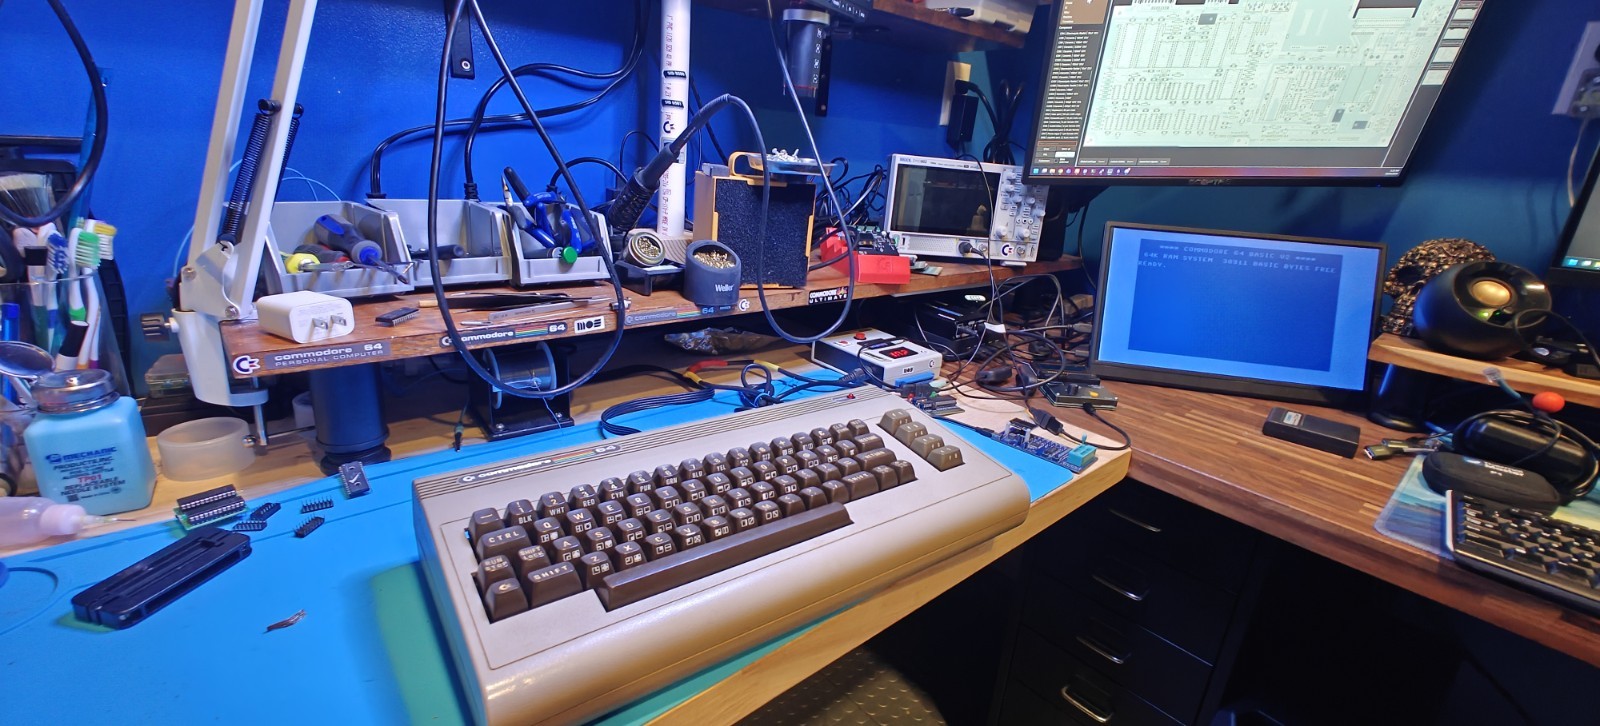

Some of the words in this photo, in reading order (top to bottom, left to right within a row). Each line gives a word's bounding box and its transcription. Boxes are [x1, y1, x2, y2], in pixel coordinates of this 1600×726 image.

[1184, 246, 1229, 255] COMMODORE
[715, 284, 735, 292] Weller
[809, 294, 847, 303] ULTIMATE
[634, 312, 676, 320] commodore
[461, 331, 514, 342] ommodore
[549, 323, 566, 333] 64
[274, 346, 352, 361] commodore
[364, 343, 383, 351] 64
[275, 356, 328, 367] PERSONAL
[333, 350, 384, 360] COMPUTER
[63, 446, 117, 461] MECHANIC
[478, 459, 552, 478] commodore
[64, 476, 118, 490] REPLACEABLE
[611, 491, 624, 499] CYN
[582, 499, 595, 507] RED
[549, 506, 565, 516] WHT
[518, 515, 532, 524] BLK
[488, 531, 520, 543] CTRL
[519, 545, 541, 556] SHIFT
[523, 552, 544, 560] LOCK
[485, 558, 503, 566] RUN
[485, 562, 508, 571] STOP
[533, 565, 568, 580] SHIFT
